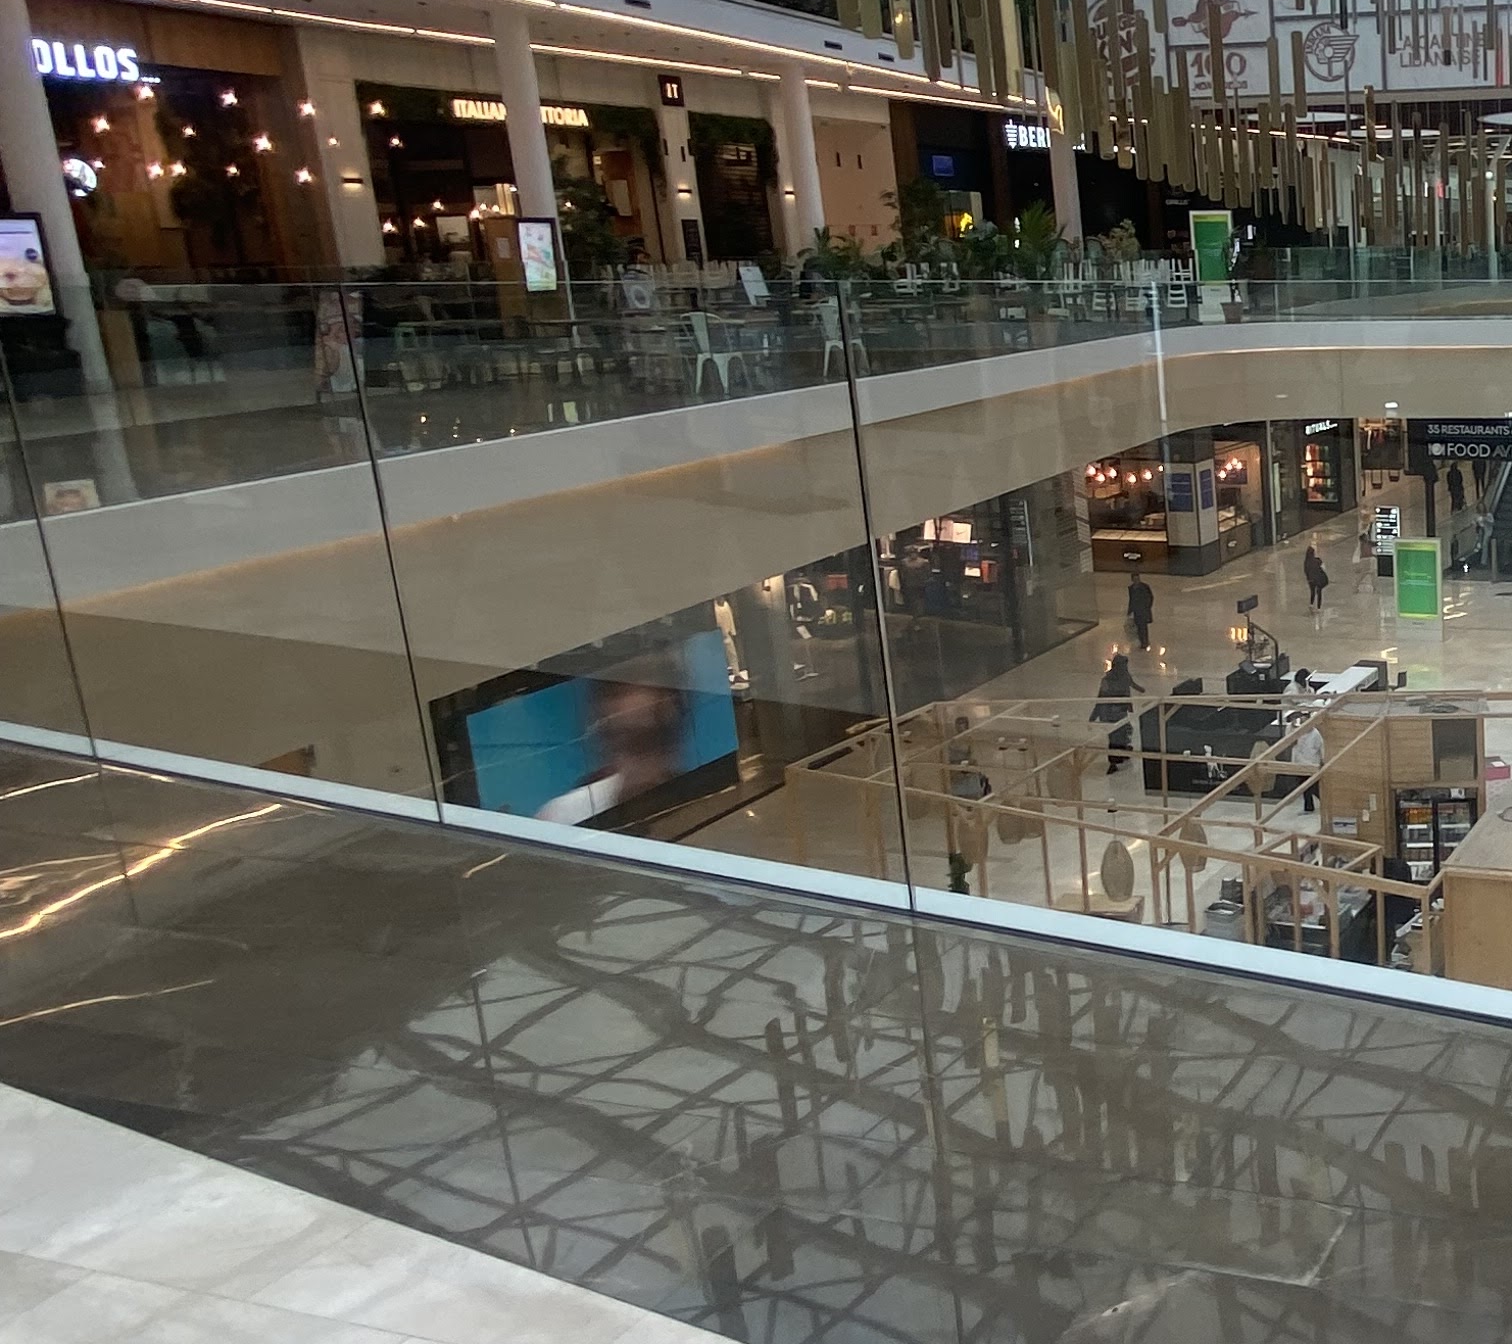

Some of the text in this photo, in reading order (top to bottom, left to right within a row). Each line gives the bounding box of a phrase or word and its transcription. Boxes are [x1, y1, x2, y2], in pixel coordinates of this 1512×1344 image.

[1427, 424, 1510, 436] 35 RESTAURANTS
[1446, 443, 1491, 457] FOOD
